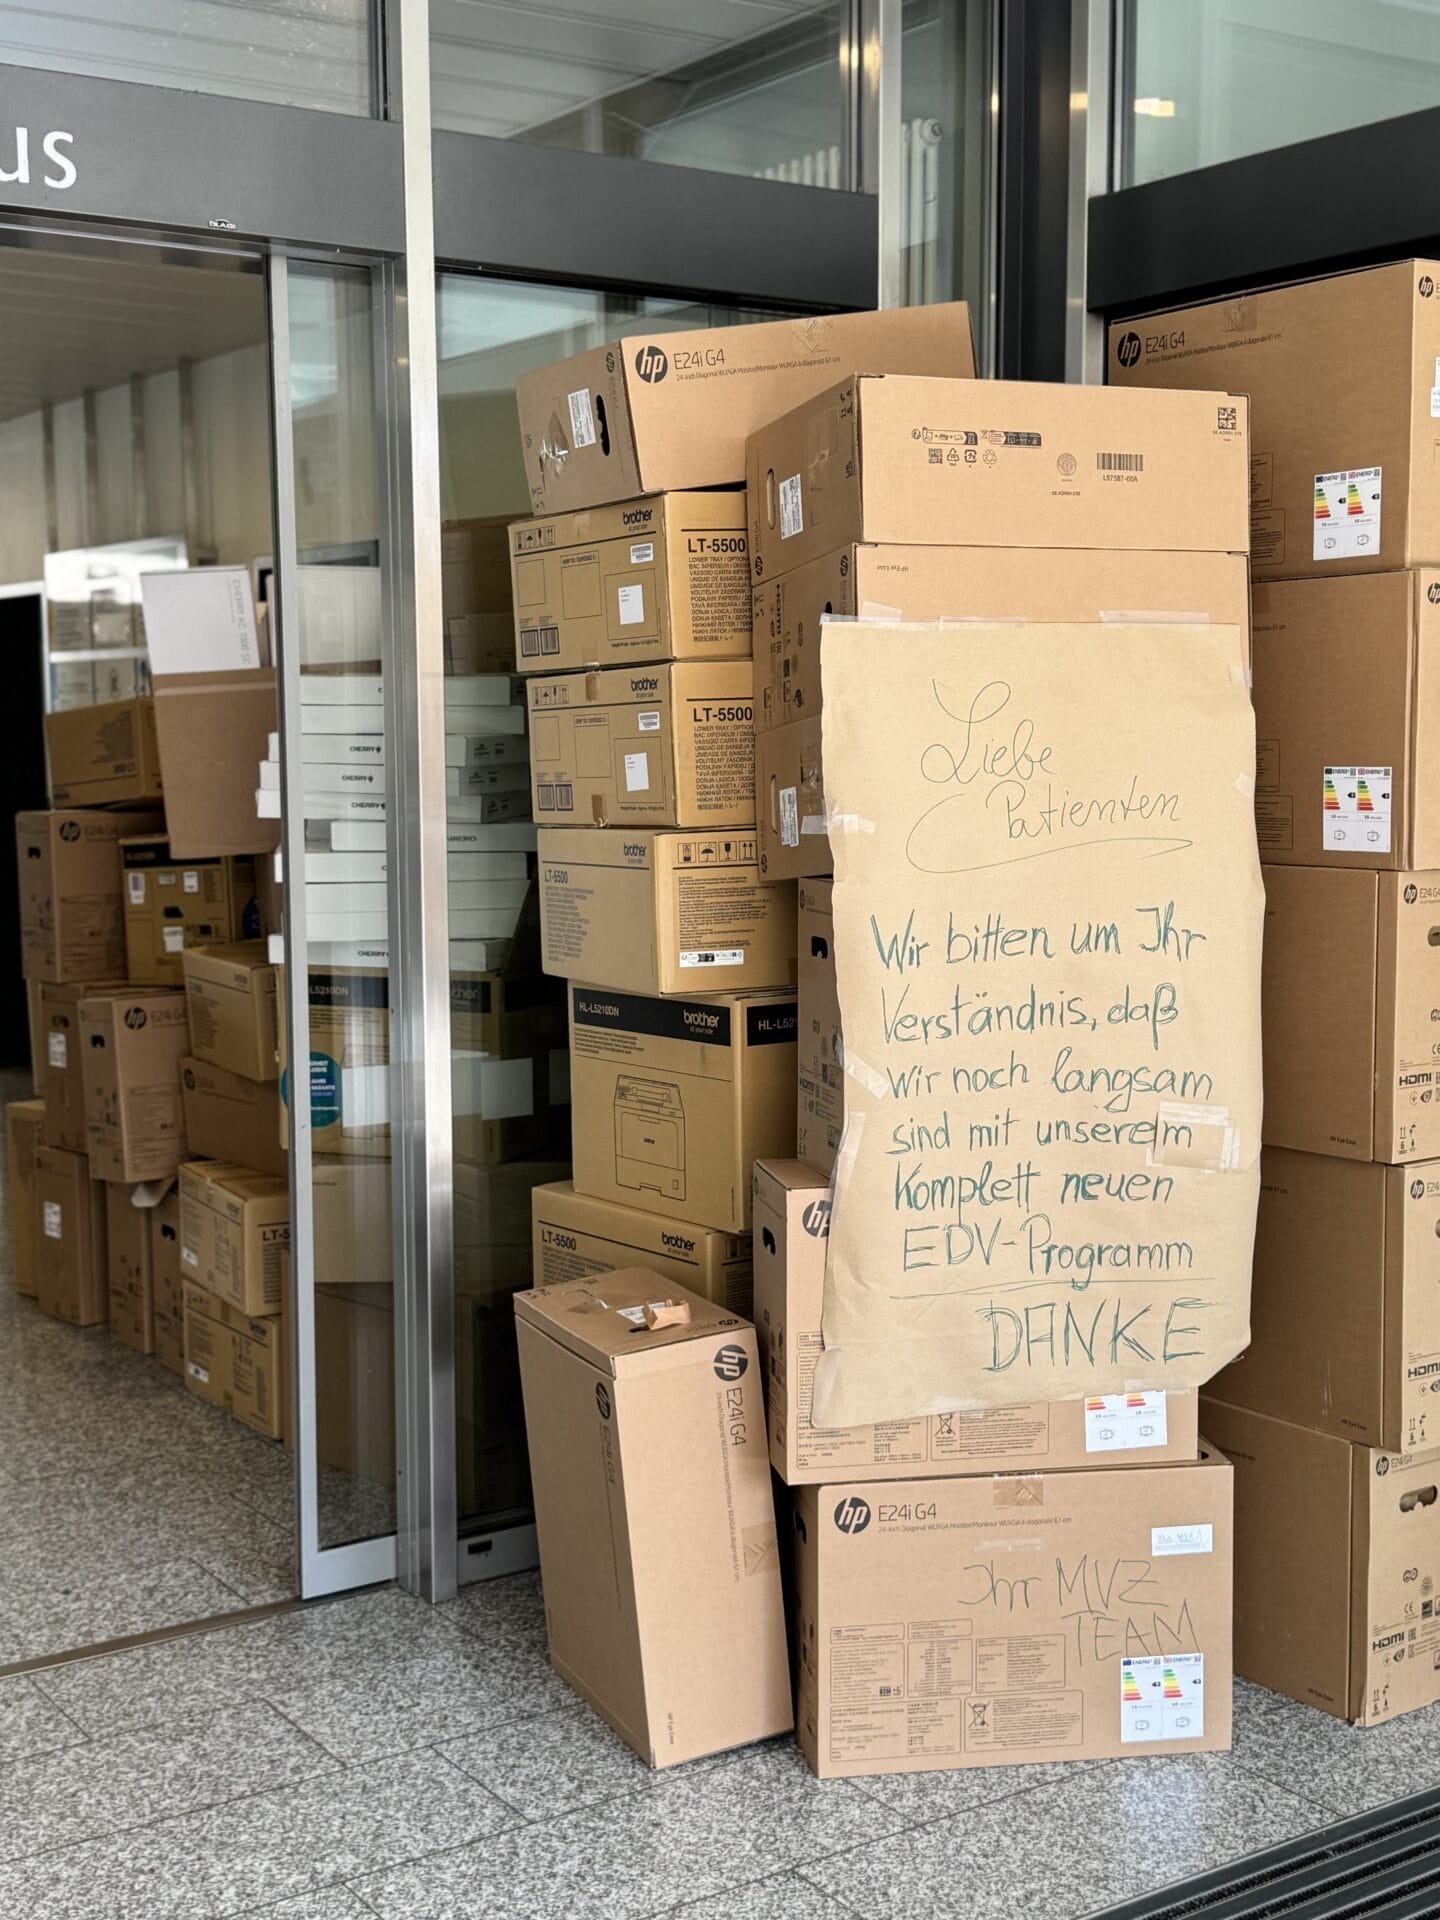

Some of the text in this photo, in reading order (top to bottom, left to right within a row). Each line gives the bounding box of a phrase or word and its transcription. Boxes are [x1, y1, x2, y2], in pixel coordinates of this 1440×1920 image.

[1418, 276, 1434, 298] hp
[1117, 331, 1142, 368] hp
[1145, 331, 1185, 354] E24i G4
[635, 346, 668, 385] hp
[673, 348, 726, 370] E24i G4
[623, 508, 653, 525] brother
[688, 538, 746, 553] LT-5500
[630, 677, 659, 692] brother
[693, 706, 753, 722] LT-5500
[920, 678, 1056, 784] Liebe
[985, 776, 1181, 840] Patienten
[623, 843, 647, 857] brother
[544, 868, 568, 884] LT-5500
[1403, 883, 1418, 905] hp
[870, 908, 930, 974] Wir
[946, 911, 1056, 964] bitten
[1070, 919, 1121, 957] um
[124, 1007, 147, 1030] hp
[683, 1009, 720, 1028] brother
[881, 982, 1179, 1051] Verständnis, daß
[952, 1049, 1029, 1093] noch
[1399, 1072, 1432, 1087] HDMI
[885, 1110, 950, 1155] sind
[968, 1107, 1020, 1149] mit
[1060, 1169, 1176, 1204] neuen
[1410, 1179, 1425, 1200] hp
[541, 1229, 577, 1250] LT-5500
[661, 1231, 696, 1251] brother
[902, 1213, 1194, 1291] EDV-Programm
[975, 1297, 1219, 1372] DANKE
[714, 1344, 749, 1382] hp
[596, 1382, 610, 1420] hp
[726, 1387, 748, 1448] E24i G4
[1376, 1455, 1389, 1476] hp
[834, 1496, 871, 1535] hp
[878, 1502, 937, 1522] E24i G4
[901, 1523, 926, 1533] Diagonal
[1055, 1553, 1170, 1616] MVZ
[1060, 1598, 1201, 1667] TEAM
[1372, 1631, 1405, 1650] HDMI
